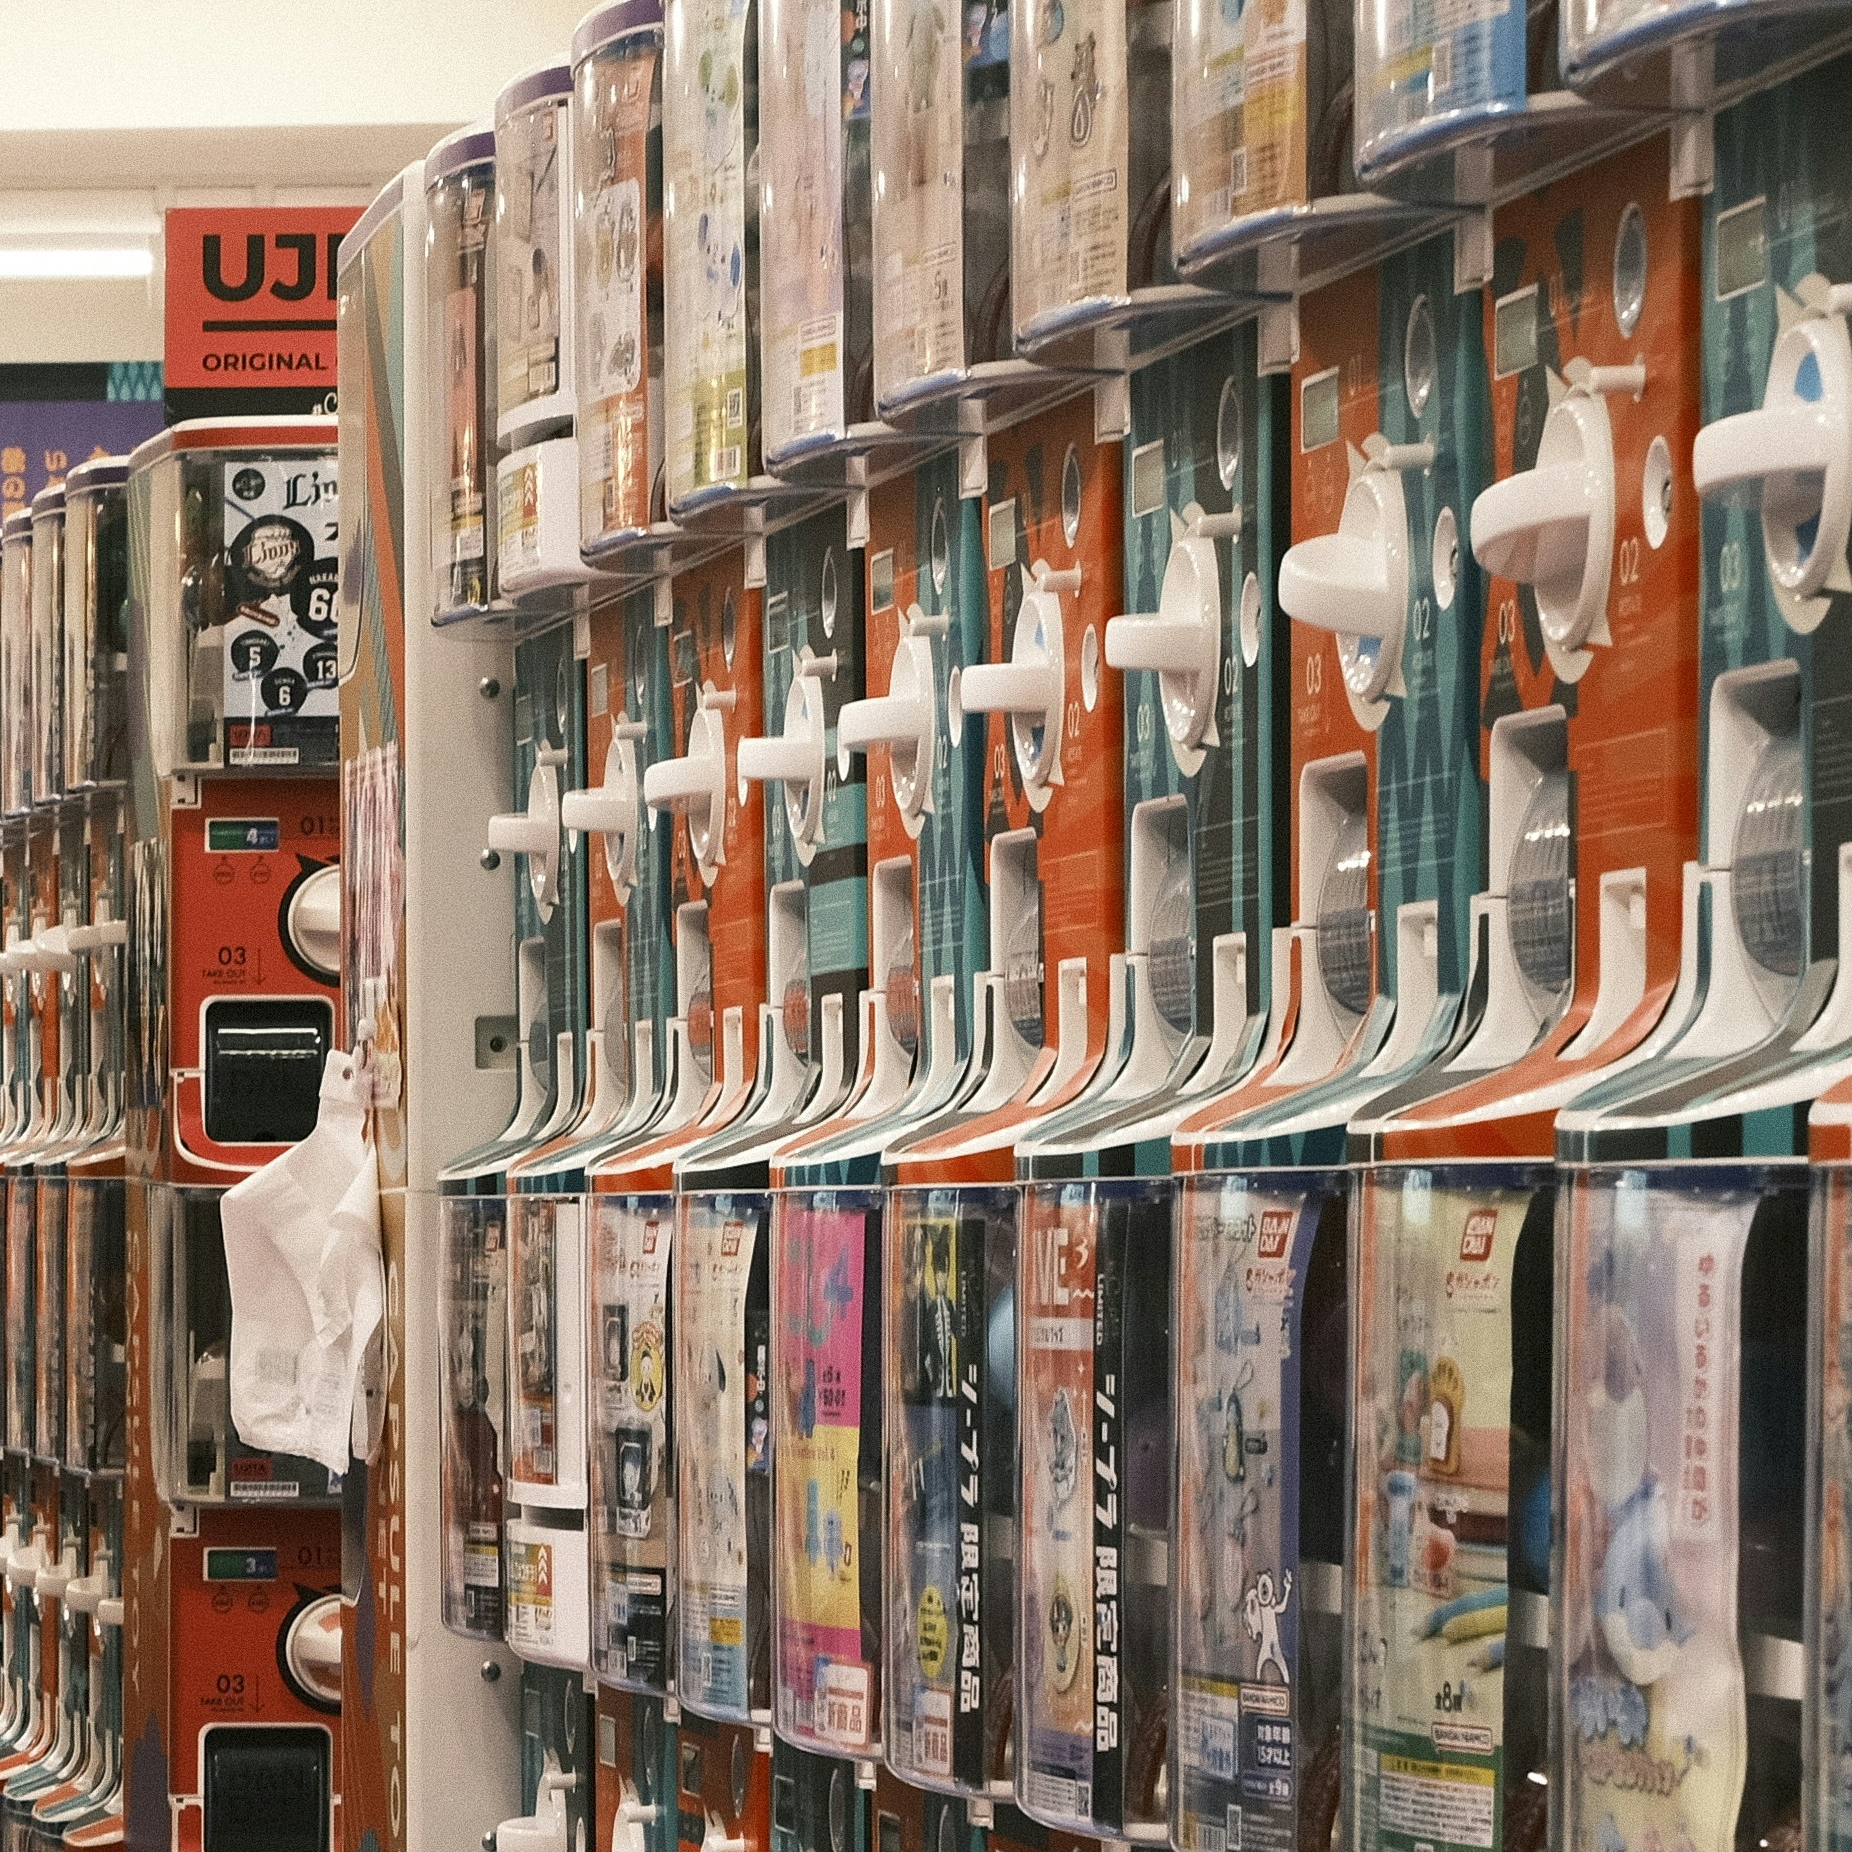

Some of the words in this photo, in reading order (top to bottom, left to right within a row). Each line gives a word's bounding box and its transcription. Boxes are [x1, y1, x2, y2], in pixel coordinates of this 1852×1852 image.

[202, 352, 327, 372] ORIGINAL
[1619, 537, 1640, 586] 02
[1412, 597, 1430, 642] 02
[278, 684, 291, 707] 6
[217, 946, 247, 966] 03
[1095, 1373, 1118, 1529] シープラ
[960, 1522, 981, 1714] 限定商品
[1095, 1545, 1118, 1752] 限定商品
[216, 1674, 245, 1695] 03
